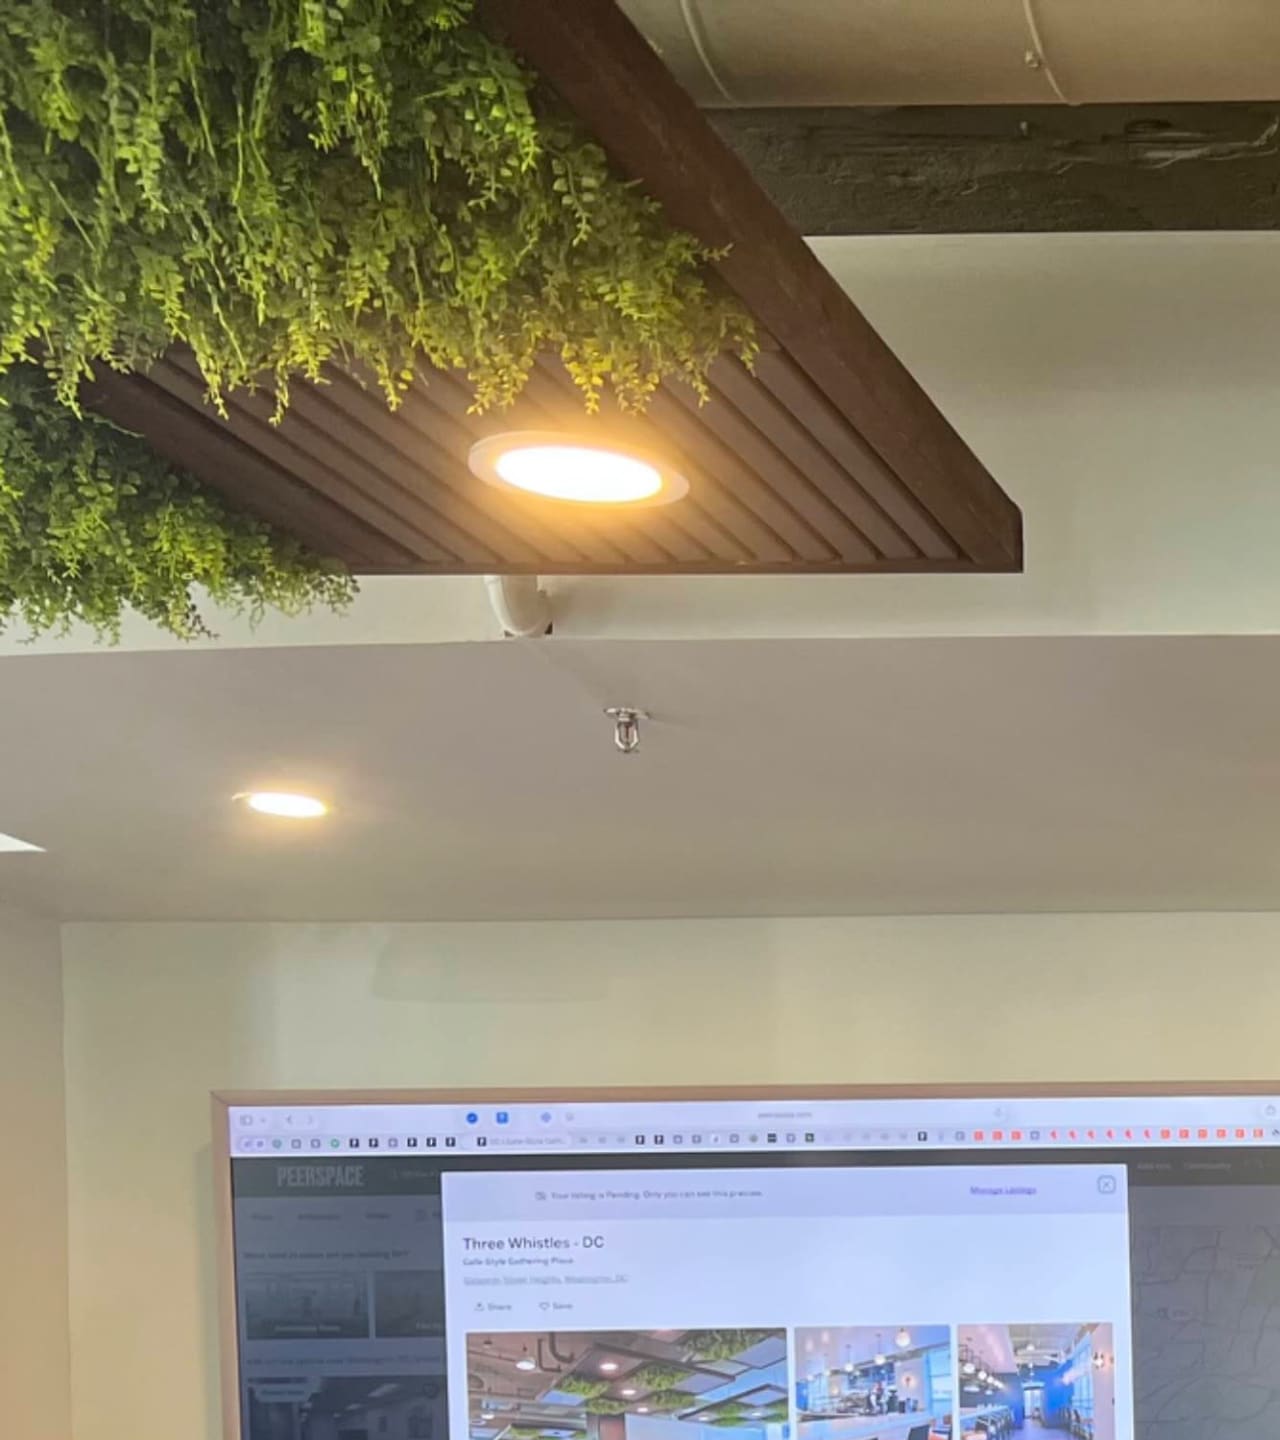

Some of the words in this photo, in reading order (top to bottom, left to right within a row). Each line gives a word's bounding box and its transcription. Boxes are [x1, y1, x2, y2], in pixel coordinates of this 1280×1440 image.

[278, 1165, 364, 1187] PEERSPACE
[463, 1237, 505, 1250] Three
[508, 1236, 570, 1249] Whistles
[582, 1235, 605, 1249] DC
